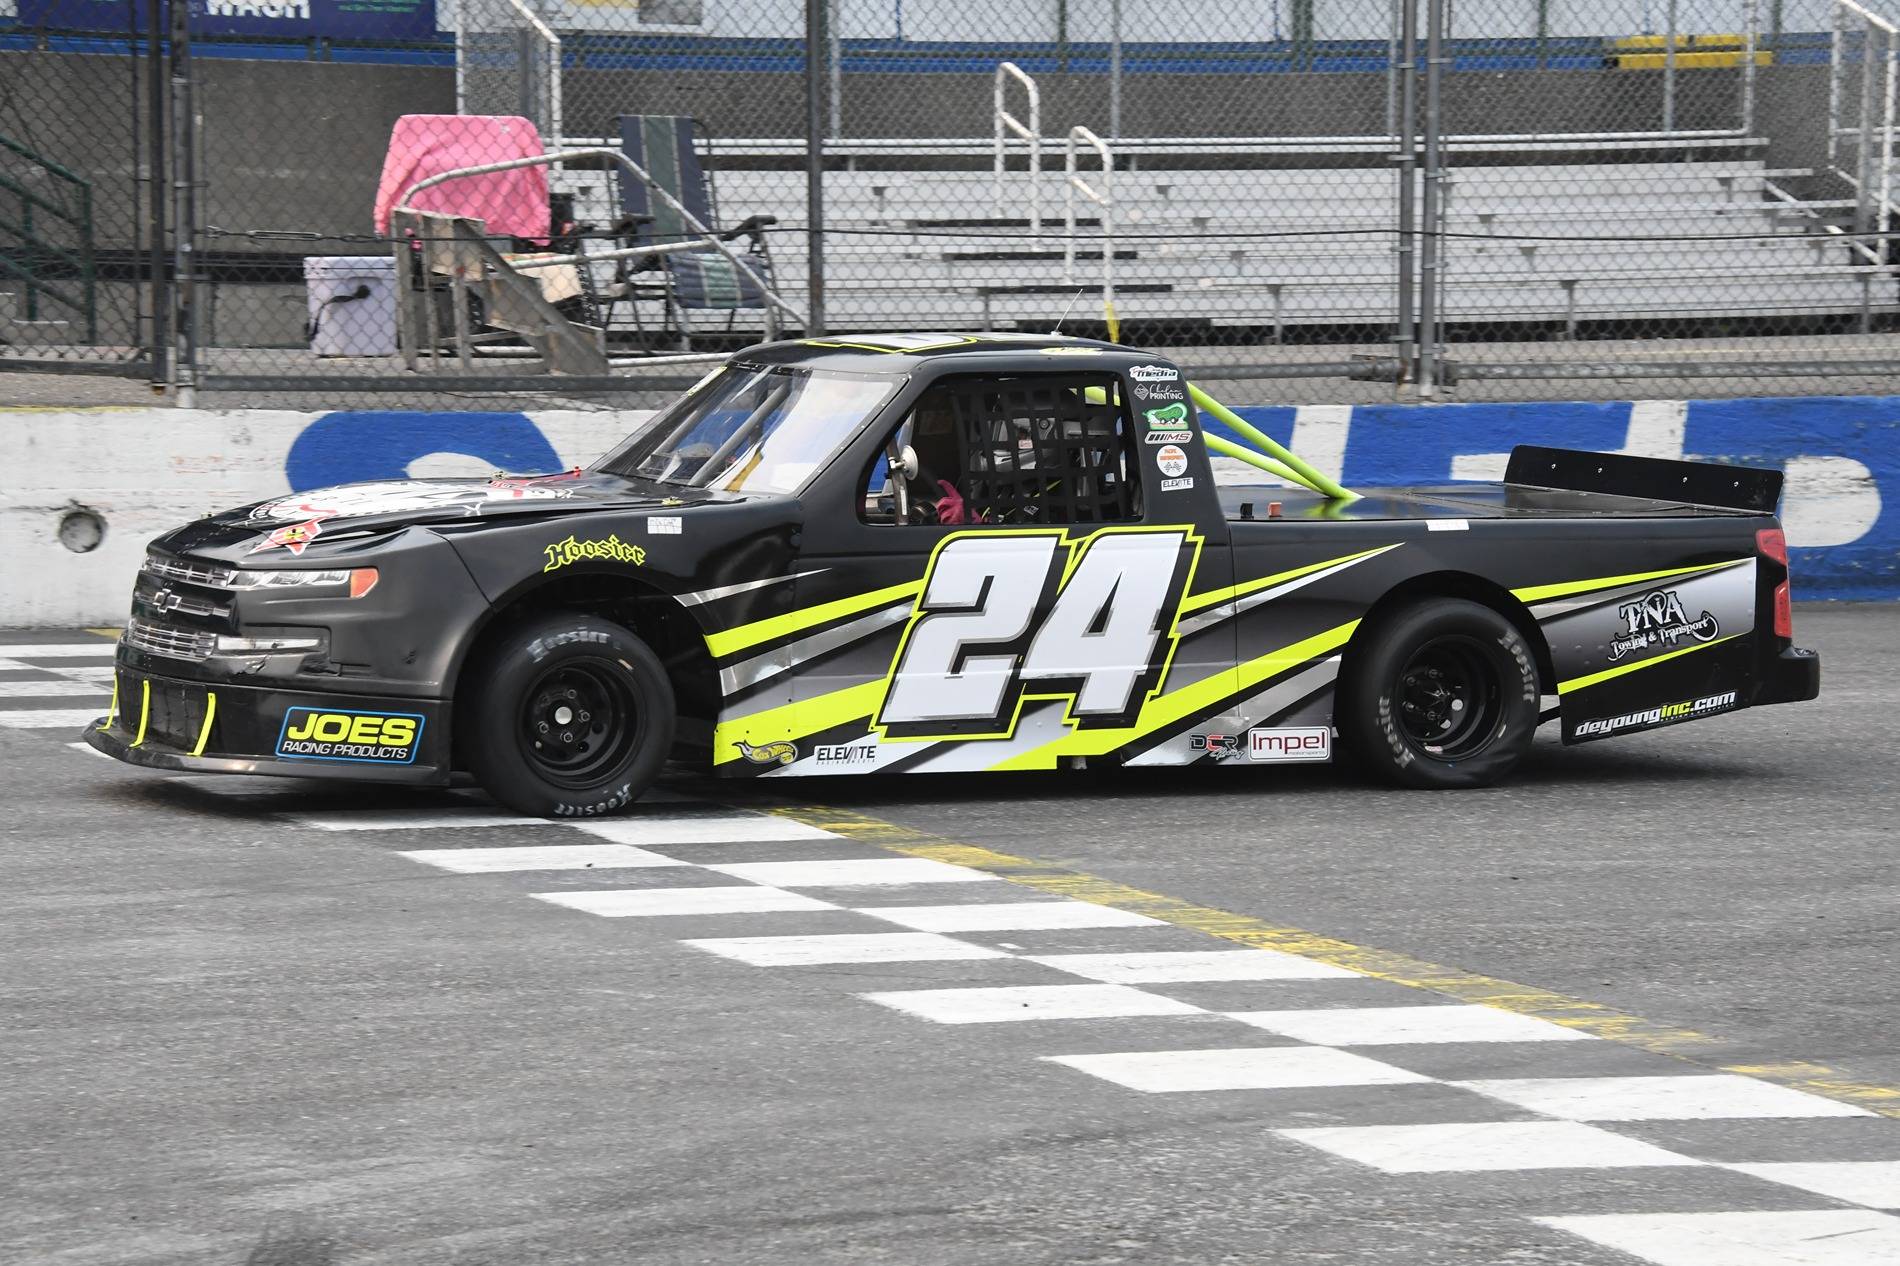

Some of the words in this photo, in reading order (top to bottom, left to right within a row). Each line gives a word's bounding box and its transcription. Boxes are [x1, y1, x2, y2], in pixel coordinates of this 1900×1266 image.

[1150, 392, 1184, 400] PRINTING
[544, 534, 646, 573] Hoosier
[880, 531, 1196, 733] 24
[1609, 634, 1647, 658] Towing
[1648, 631, 1657, 643] &
[1658, 618, 1709, 644] Transport
[287, 713, 416, 746] JOES
[1575, 691, 1736, 737] deyounginc.com
[282, 740, 331, 754] RACING
[333, 744, 408, 759] PRODUCTS
[1253, 732, 1325, 754] Impel
